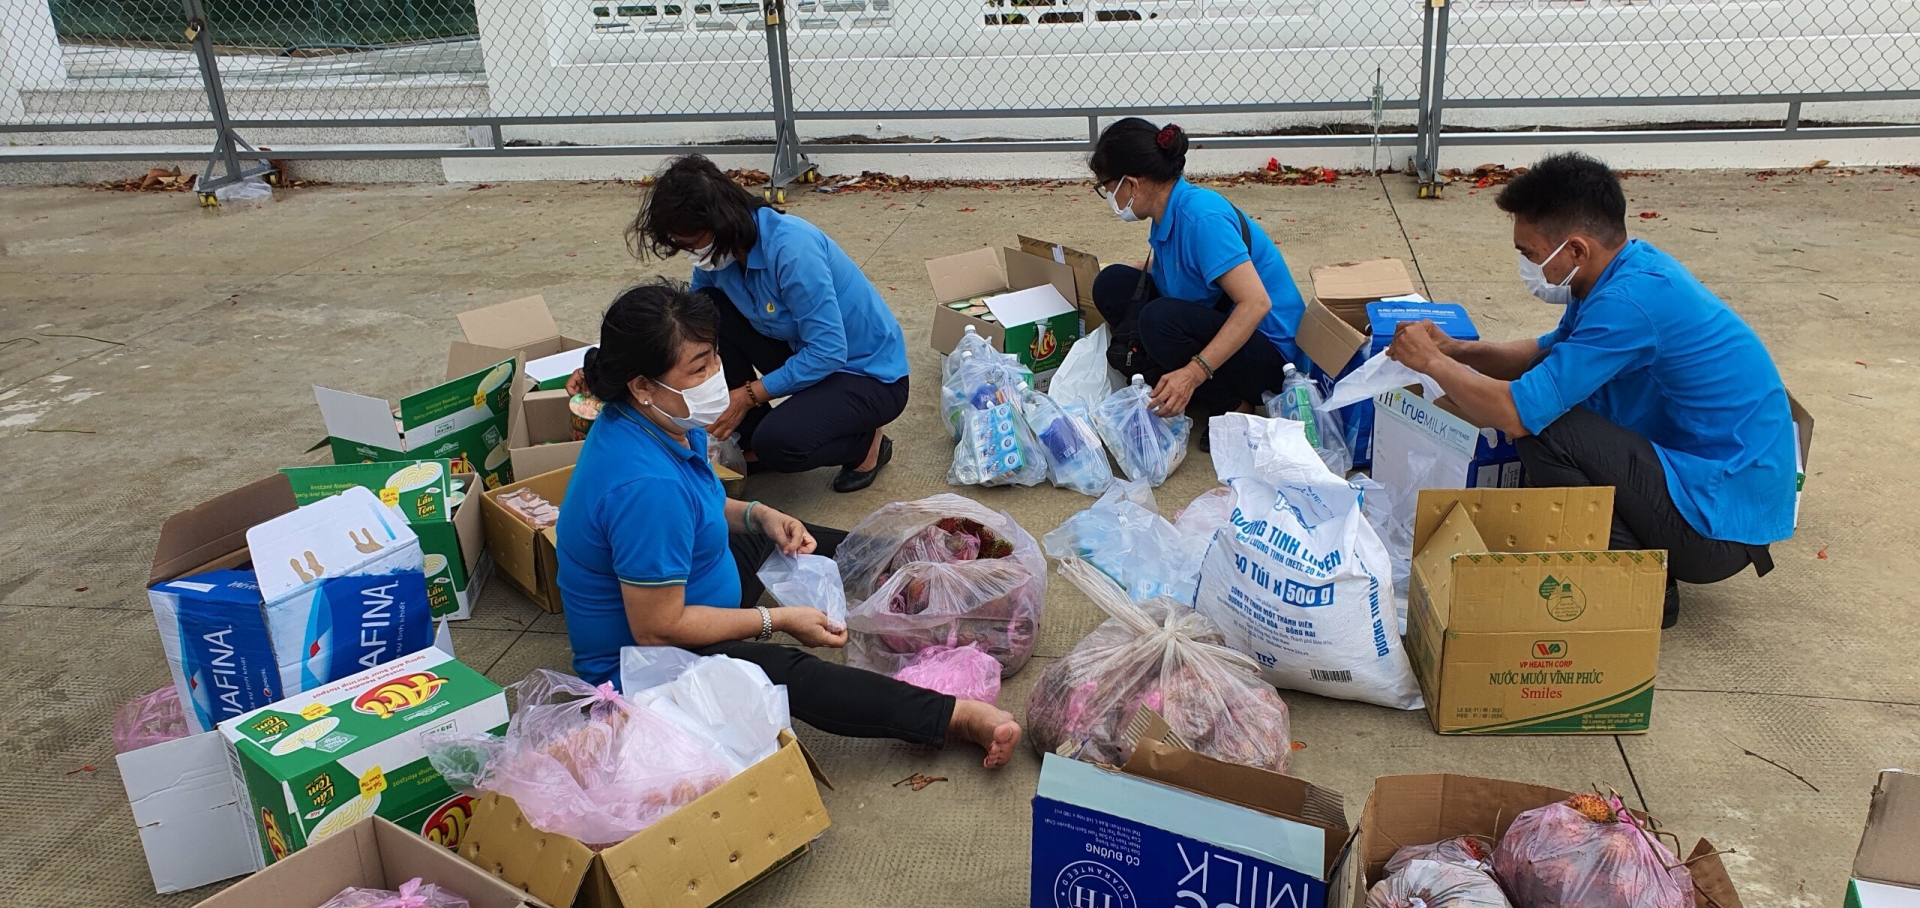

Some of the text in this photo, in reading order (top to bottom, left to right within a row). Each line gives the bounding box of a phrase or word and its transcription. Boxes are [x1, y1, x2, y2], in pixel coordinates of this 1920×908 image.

[1269, 526, 1302, 556] TINH
[1305, 566, 1316, 576] 20
[1286, 583, 1316, 604] 500
[1320, 588, 1331, 604] g
[1244, 604, 1252, 614] TTC
[1369, 592, 1379, 618] TINH
[358, 580, 399, 669] AFINA
[1263, 608, 1276, 620] MỘT
[1277, 614, 1297, 626] THÀNH
[1256, 651, 1276, 666] TTC
[1528, 660, 1554, 668] HEALTH
[1554, 660, 1573, 668] CORP
[1489, 670, 1518, 685] NƯỚC
[1550, 669, 1574, 684] VĨNH
[1576, 668, 1604, 684] PHÚC
[362, 672, 450, 720] Ari
[1521, 688, 1562, 699] Smiles
[308, 775, 332, 796] Tôm
[392, 773, 418, 788] Hotpot
[416, 772, 442, 786] oodles
[312, 786, 334, 807] Lẩu
[1086, 843, 1140, 866] CÓ ĐƯỜNG
[1061, 866, 1129, 900] GUARANTEED
[1177, 842, 1309, 908] MILK
